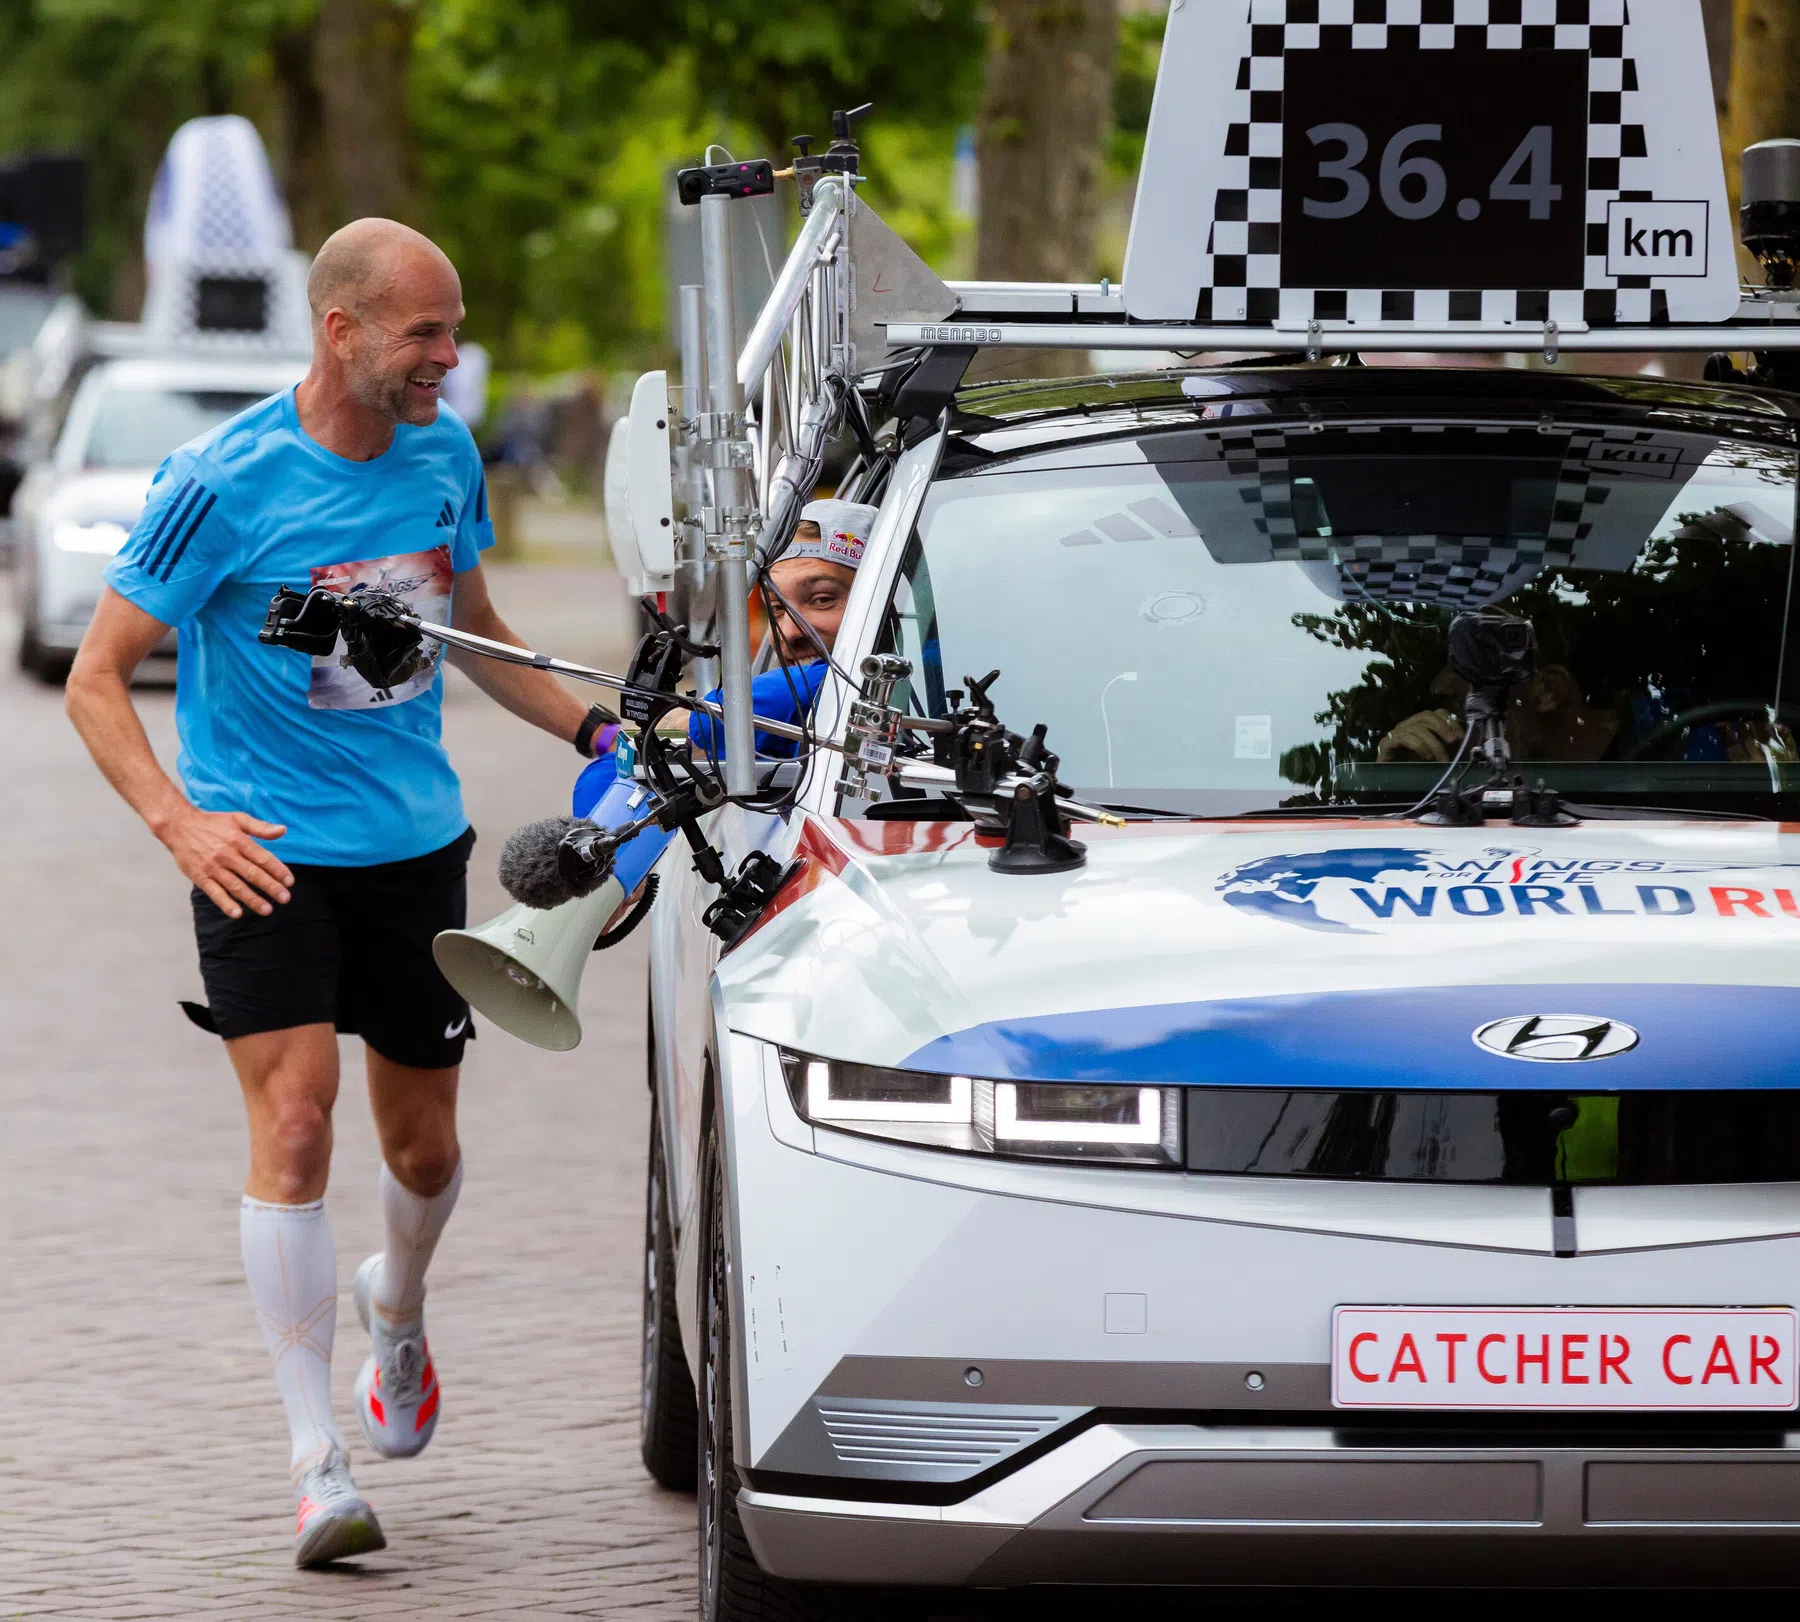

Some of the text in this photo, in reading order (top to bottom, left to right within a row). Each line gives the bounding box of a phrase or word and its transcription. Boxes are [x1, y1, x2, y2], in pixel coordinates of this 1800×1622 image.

[1302, 122, 1563, 221] 36.4
[1624, 217, 1693, 257] km
[829, 542, 864, 560] Red Bu
[1348, 885, 1696, 918] WORLD
[1348, 1331, 1784, 1386] CATCHER CAR
